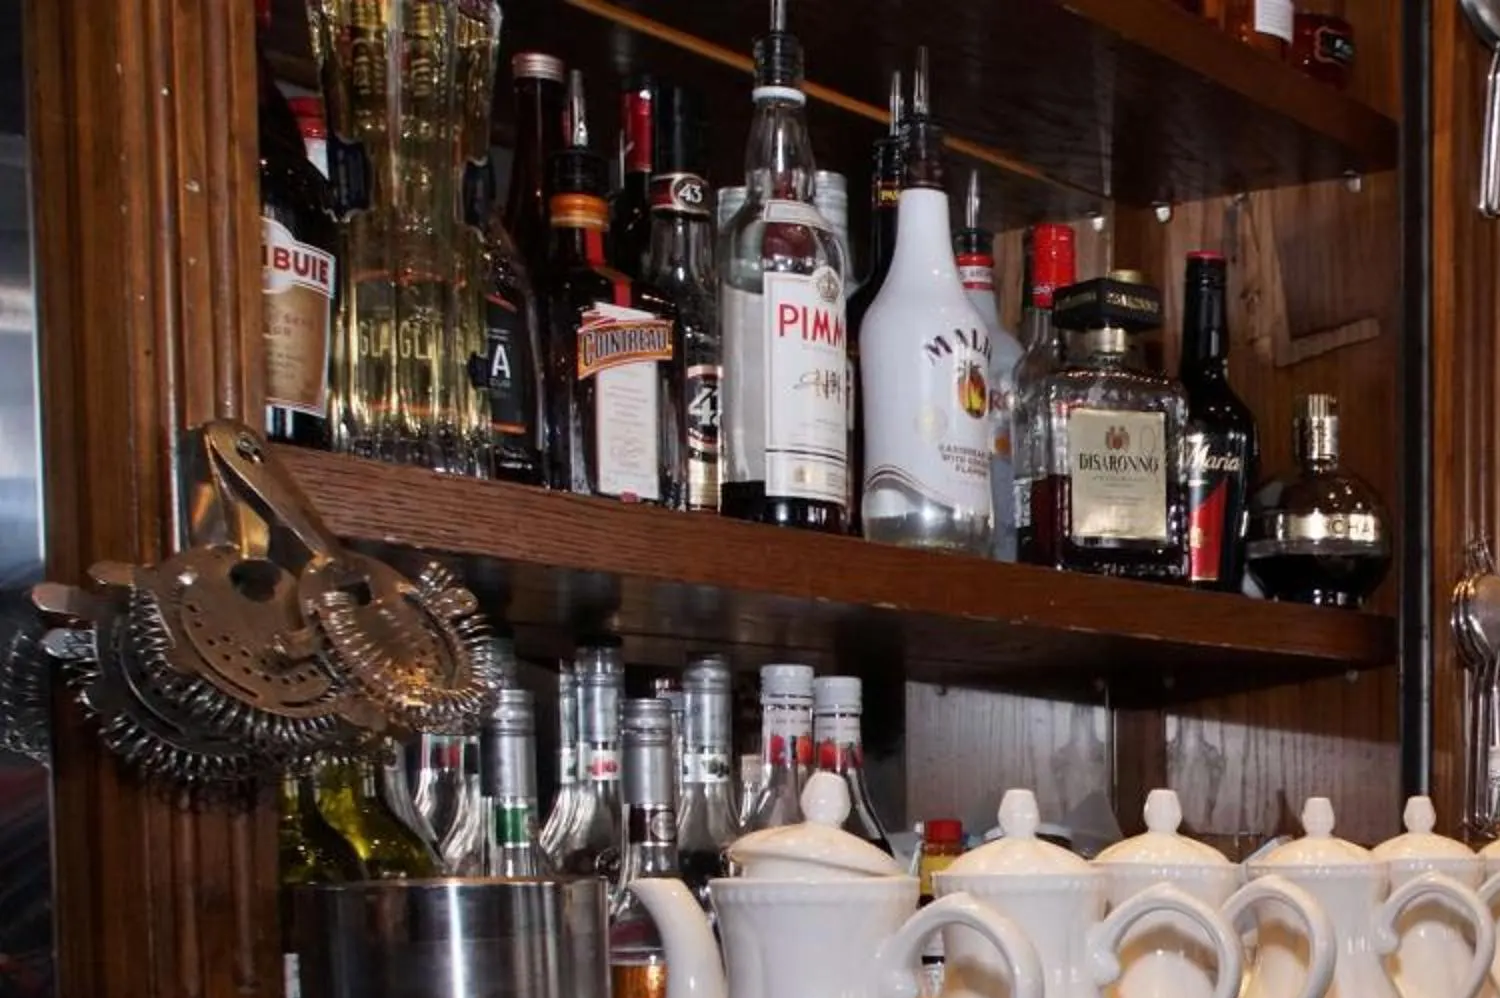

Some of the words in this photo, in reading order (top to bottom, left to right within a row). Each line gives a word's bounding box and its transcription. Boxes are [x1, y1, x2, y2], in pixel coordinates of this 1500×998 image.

[678, 183, 703, 203] 43
[261, 243, 330, 286] BUIE
[1078, 452, 1159, 474] DISARONNO
